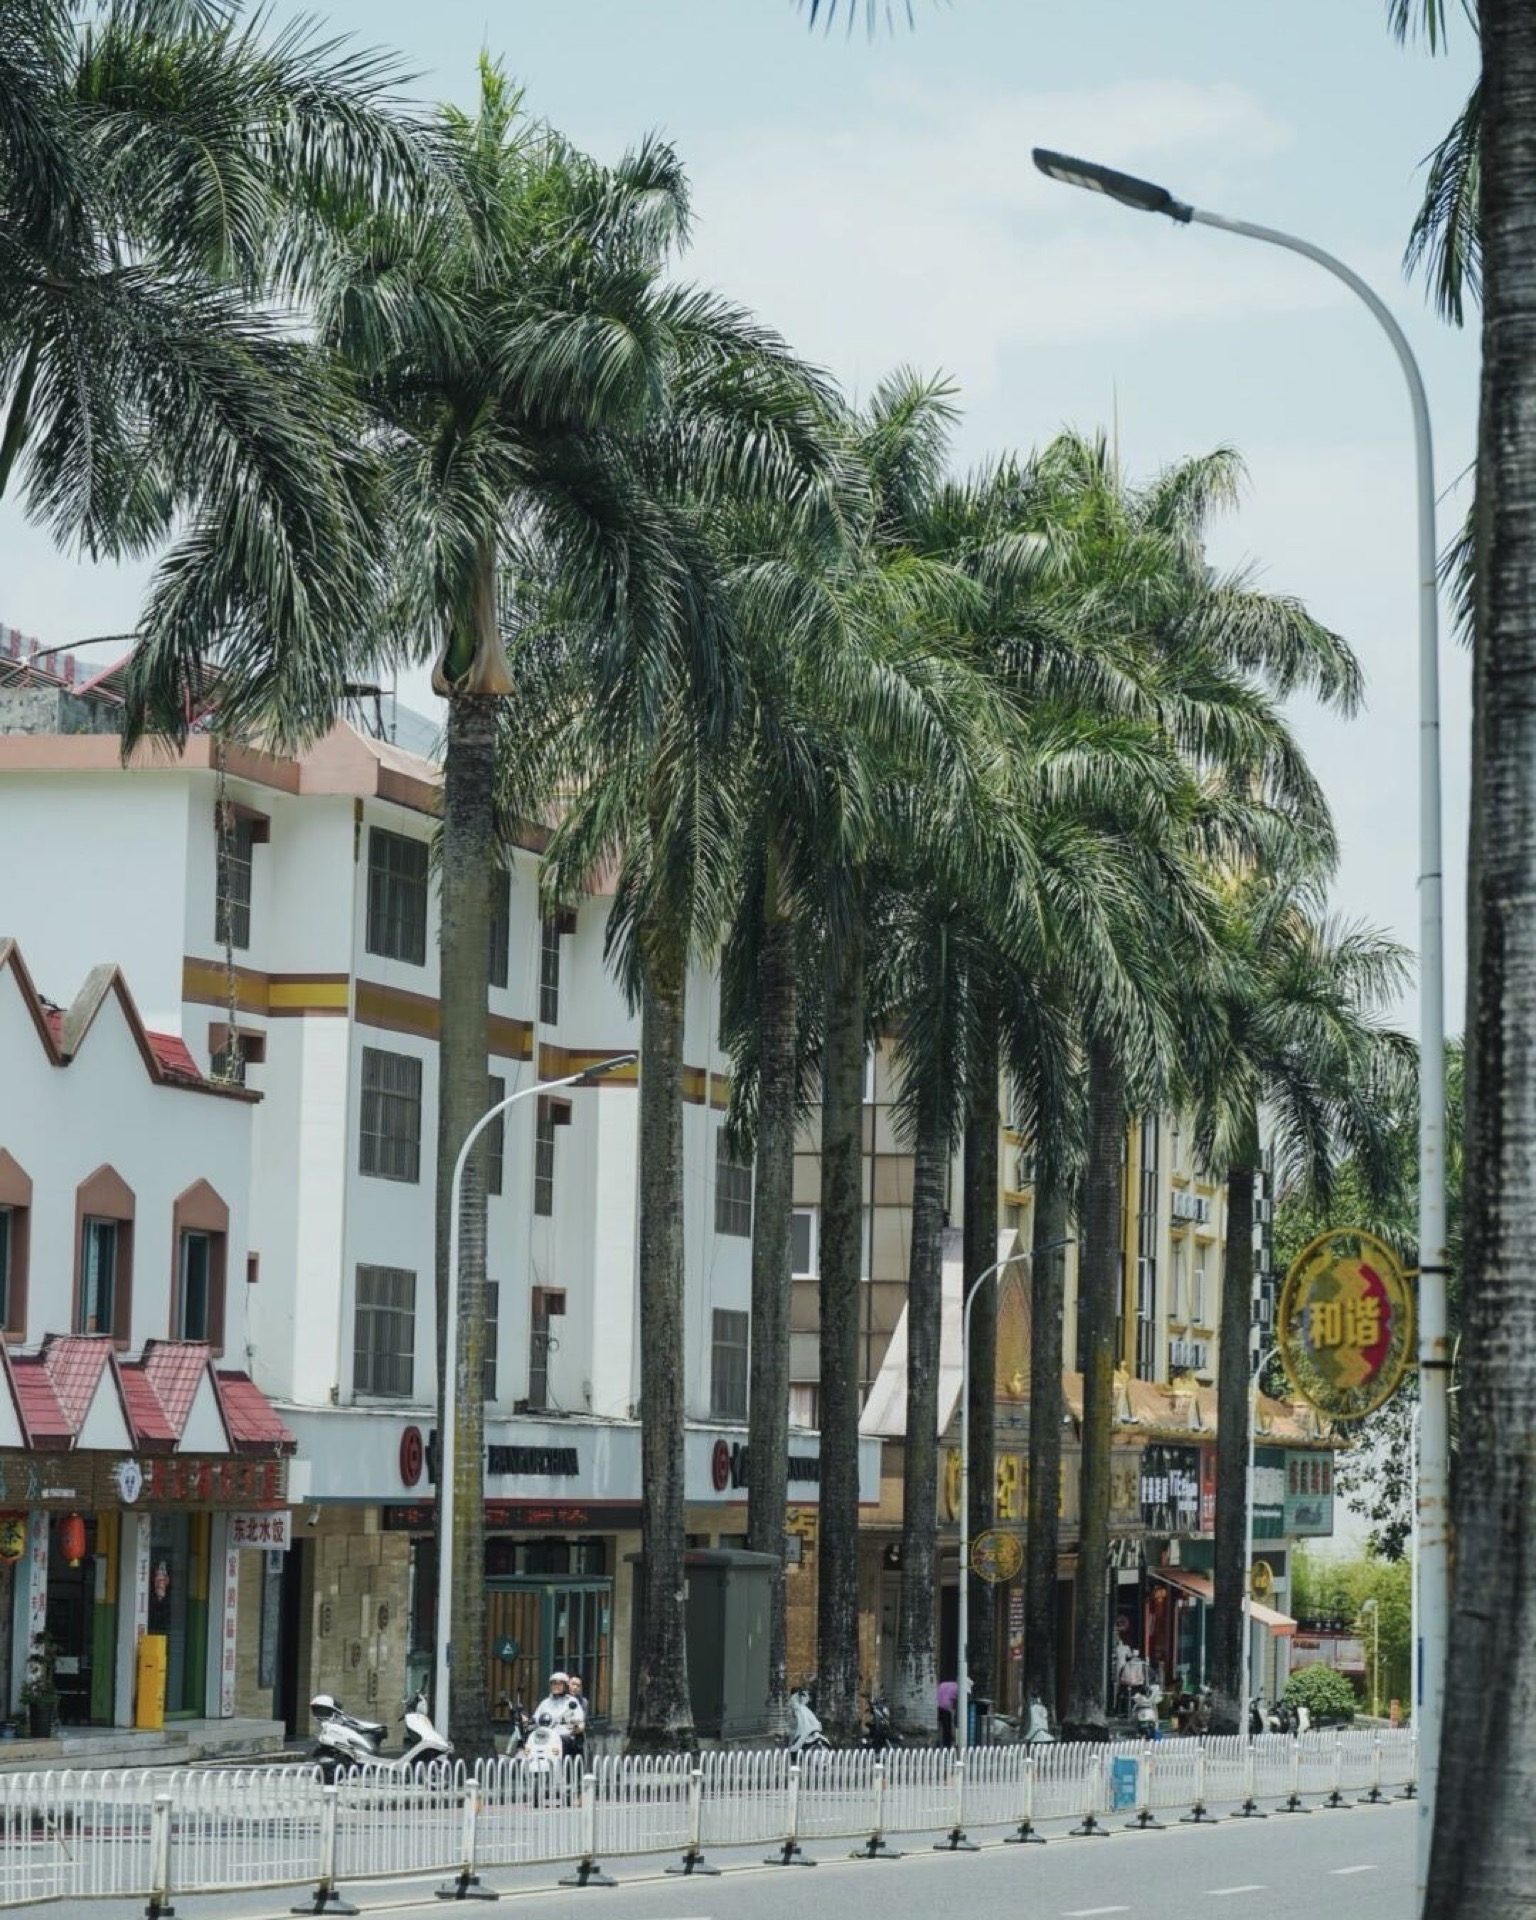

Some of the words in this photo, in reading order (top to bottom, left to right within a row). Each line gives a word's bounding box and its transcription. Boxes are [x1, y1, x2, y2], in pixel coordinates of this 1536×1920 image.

[1309, 1297, 1380, 1348] 和谐
[234, 1517, 284, 1543] 东北水饺
